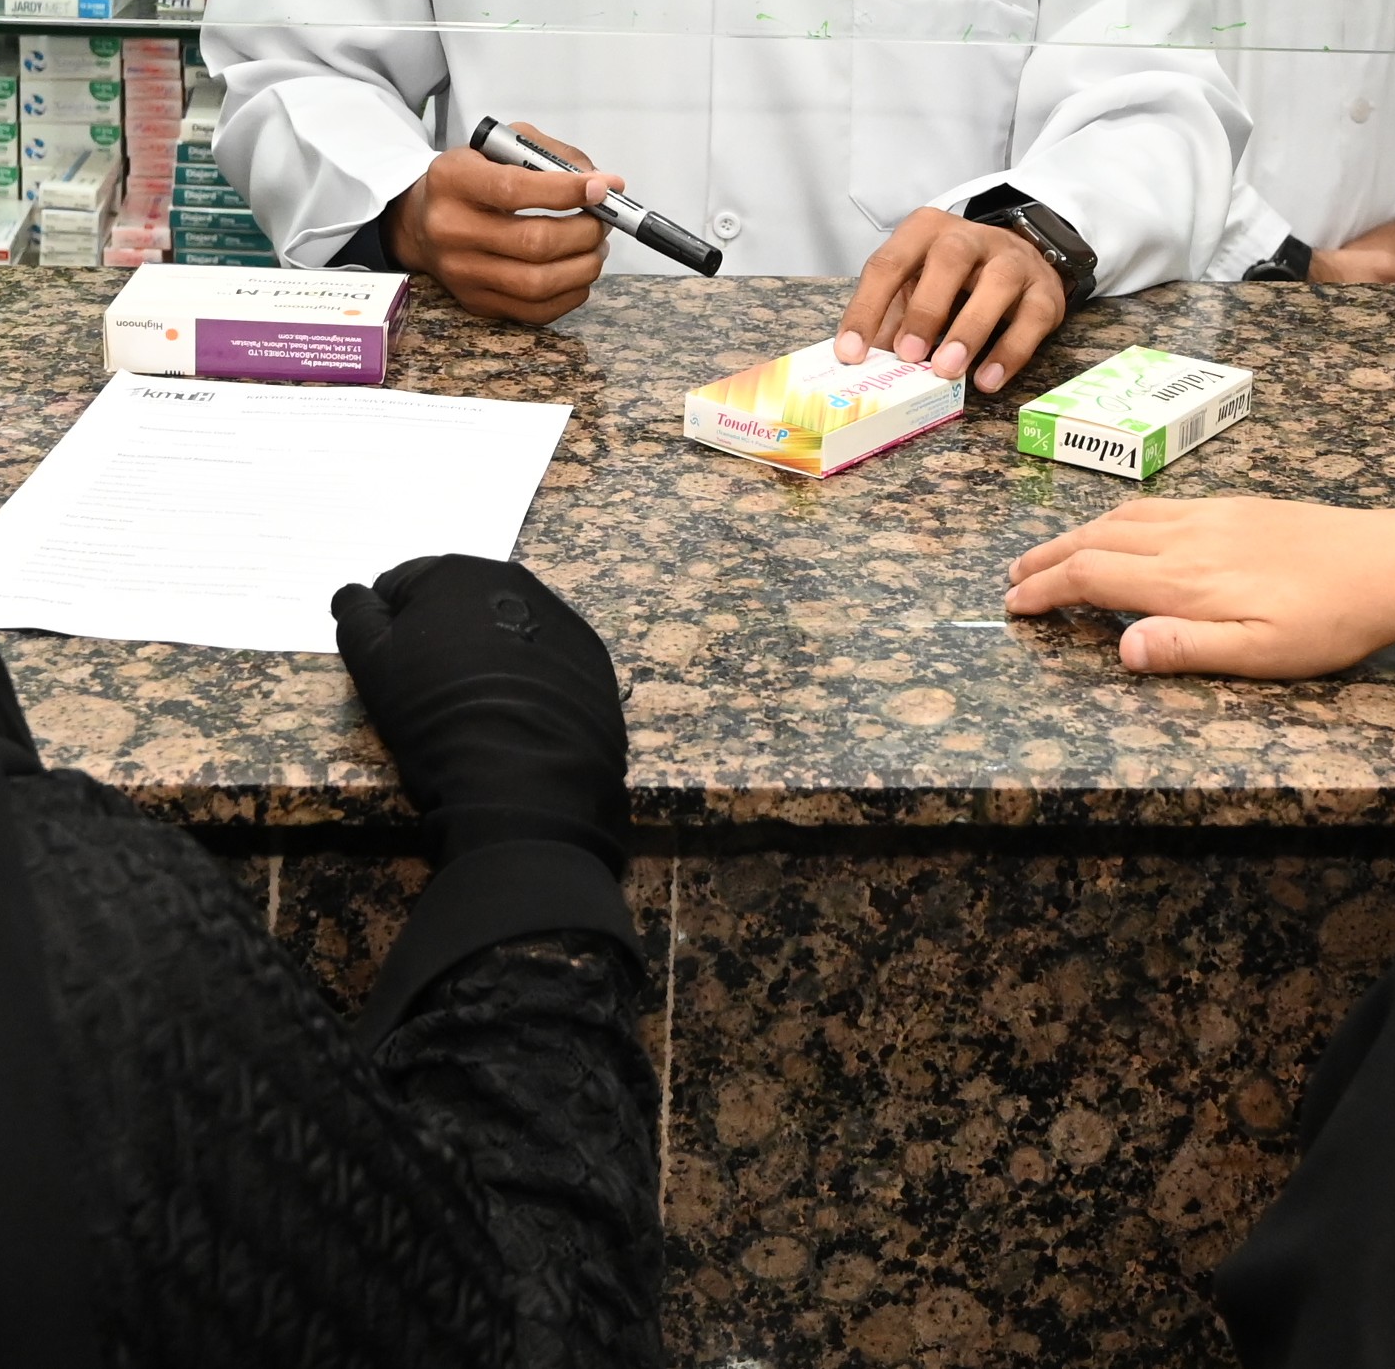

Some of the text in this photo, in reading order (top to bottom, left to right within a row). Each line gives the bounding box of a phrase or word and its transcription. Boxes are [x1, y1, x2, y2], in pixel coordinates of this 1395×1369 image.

[116, 319, 163, 330] Highnoon
[247, 349, 362, 361] HIGHNOON LABORATORIES LTD
[1151, 369, 1226, 402] Valam
[716, 411, 789, 443] Tonoflex-P
[1064, 431, 1138, 470] Valam
